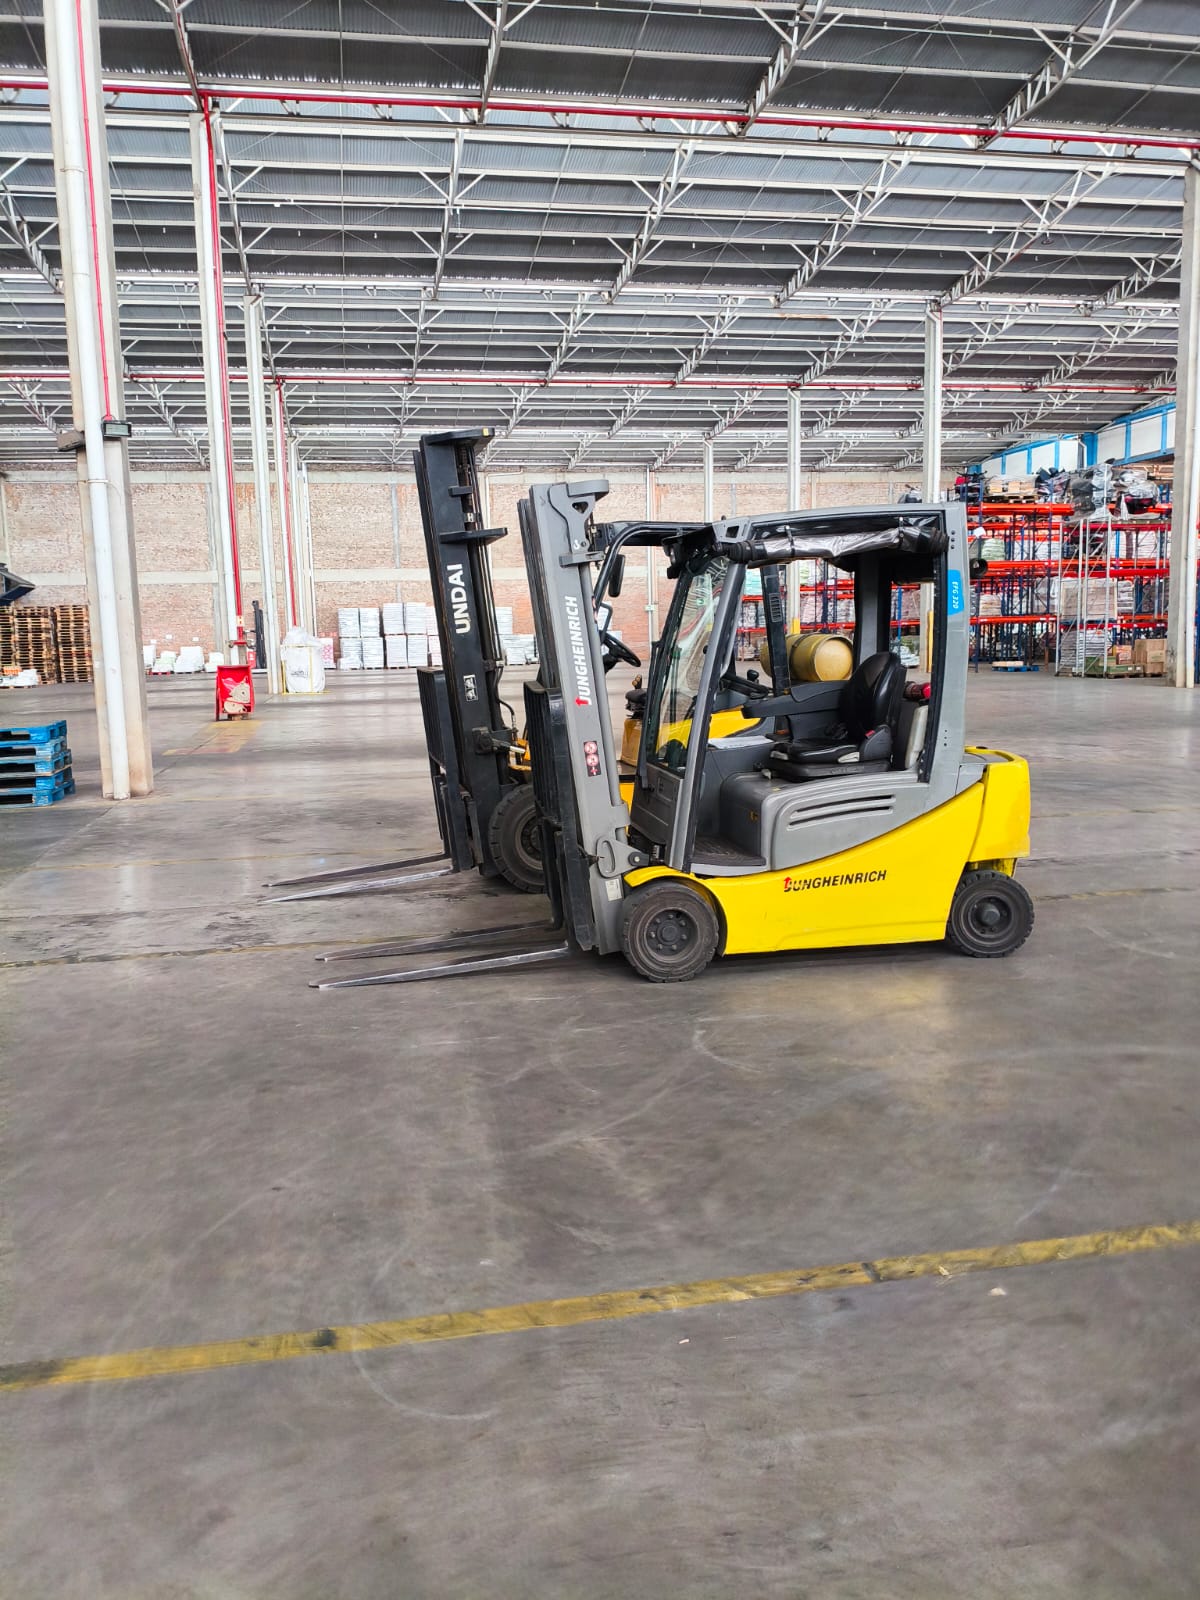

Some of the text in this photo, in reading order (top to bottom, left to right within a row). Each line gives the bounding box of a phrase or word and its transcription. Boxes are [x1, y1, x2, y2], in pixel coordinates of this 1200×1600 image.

[447, 564, 471, 634] UNDAI
[565, 596, 592, 707] JUNGHEINRICH
[783, 869, 887, 893] JUNGHEINRICH
